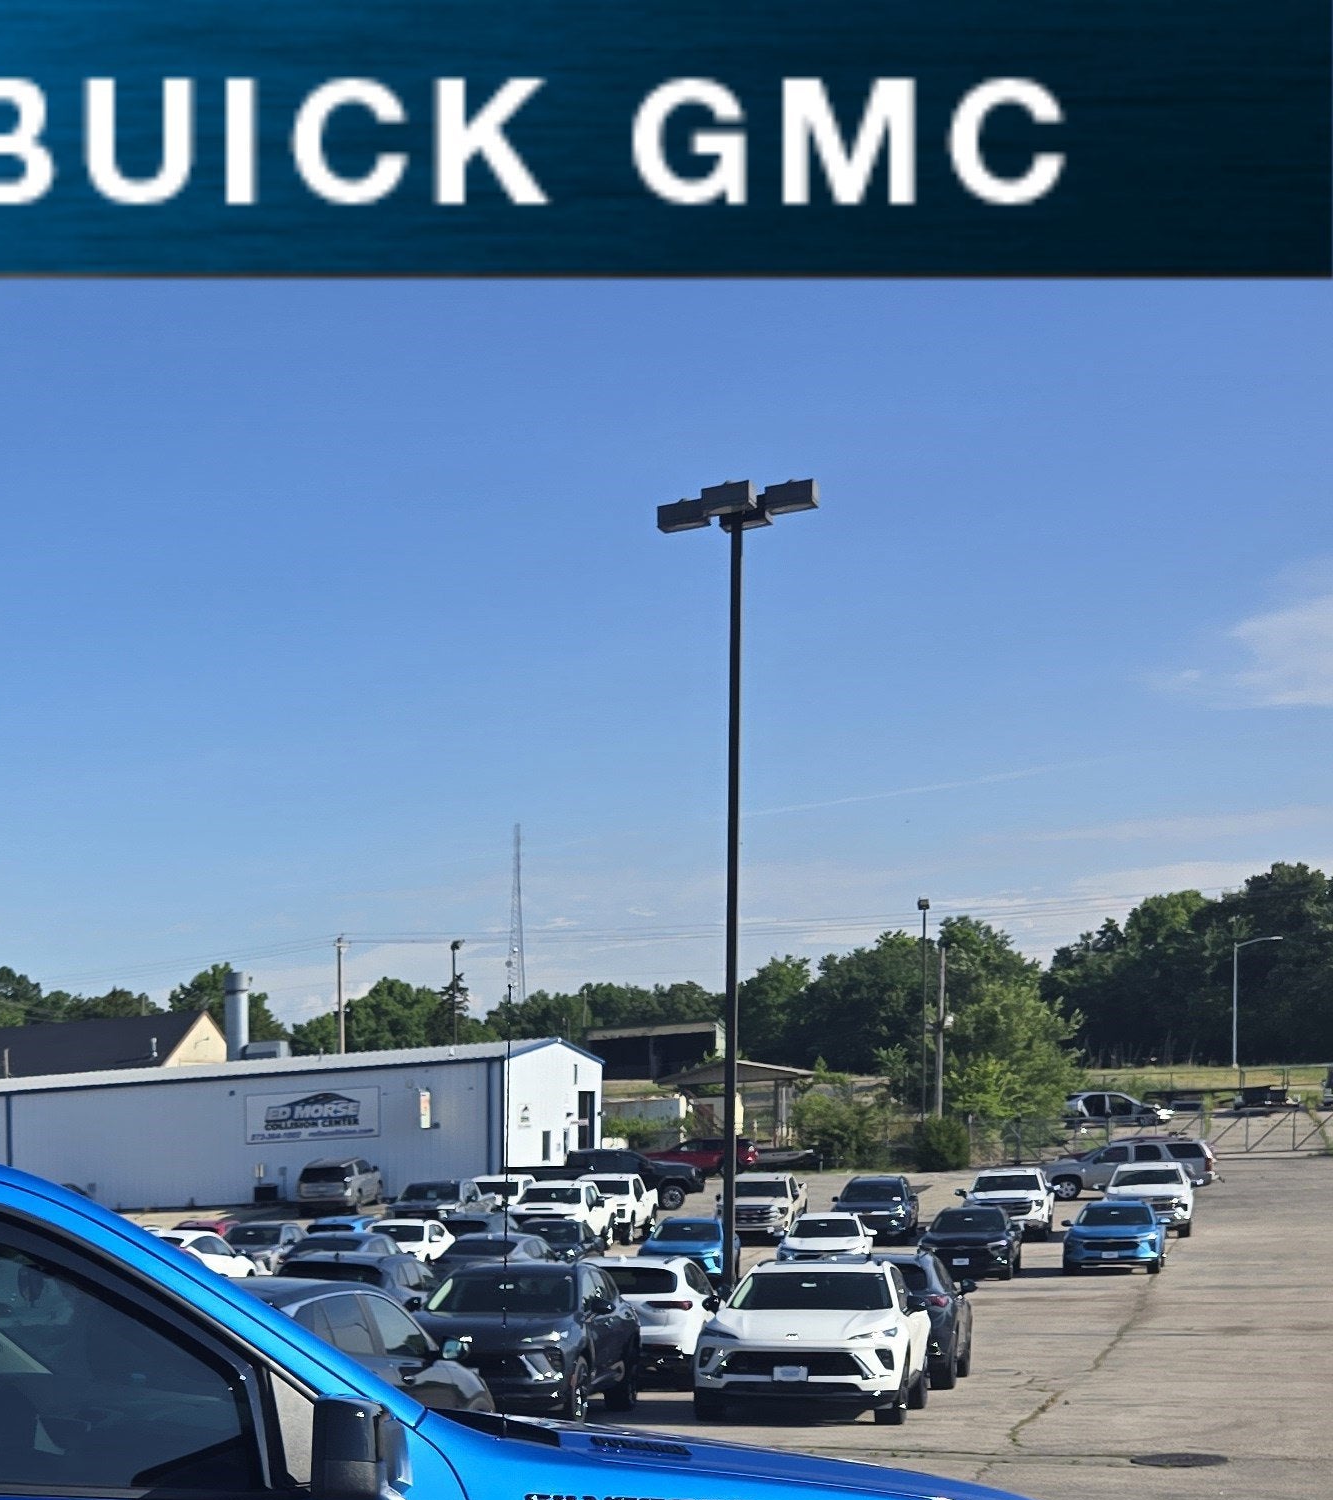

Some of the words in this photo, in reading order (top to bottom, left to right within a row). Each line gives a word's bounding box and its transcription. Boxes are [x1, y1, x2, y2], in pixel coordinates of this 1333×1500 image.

[266, 1106, 291, 1120] ED
[294, 1102, 359, 1119] MORSE
[265, 1120, 318, 1131] COLLISION
[321, 1118, 359, 1128] CENTER
